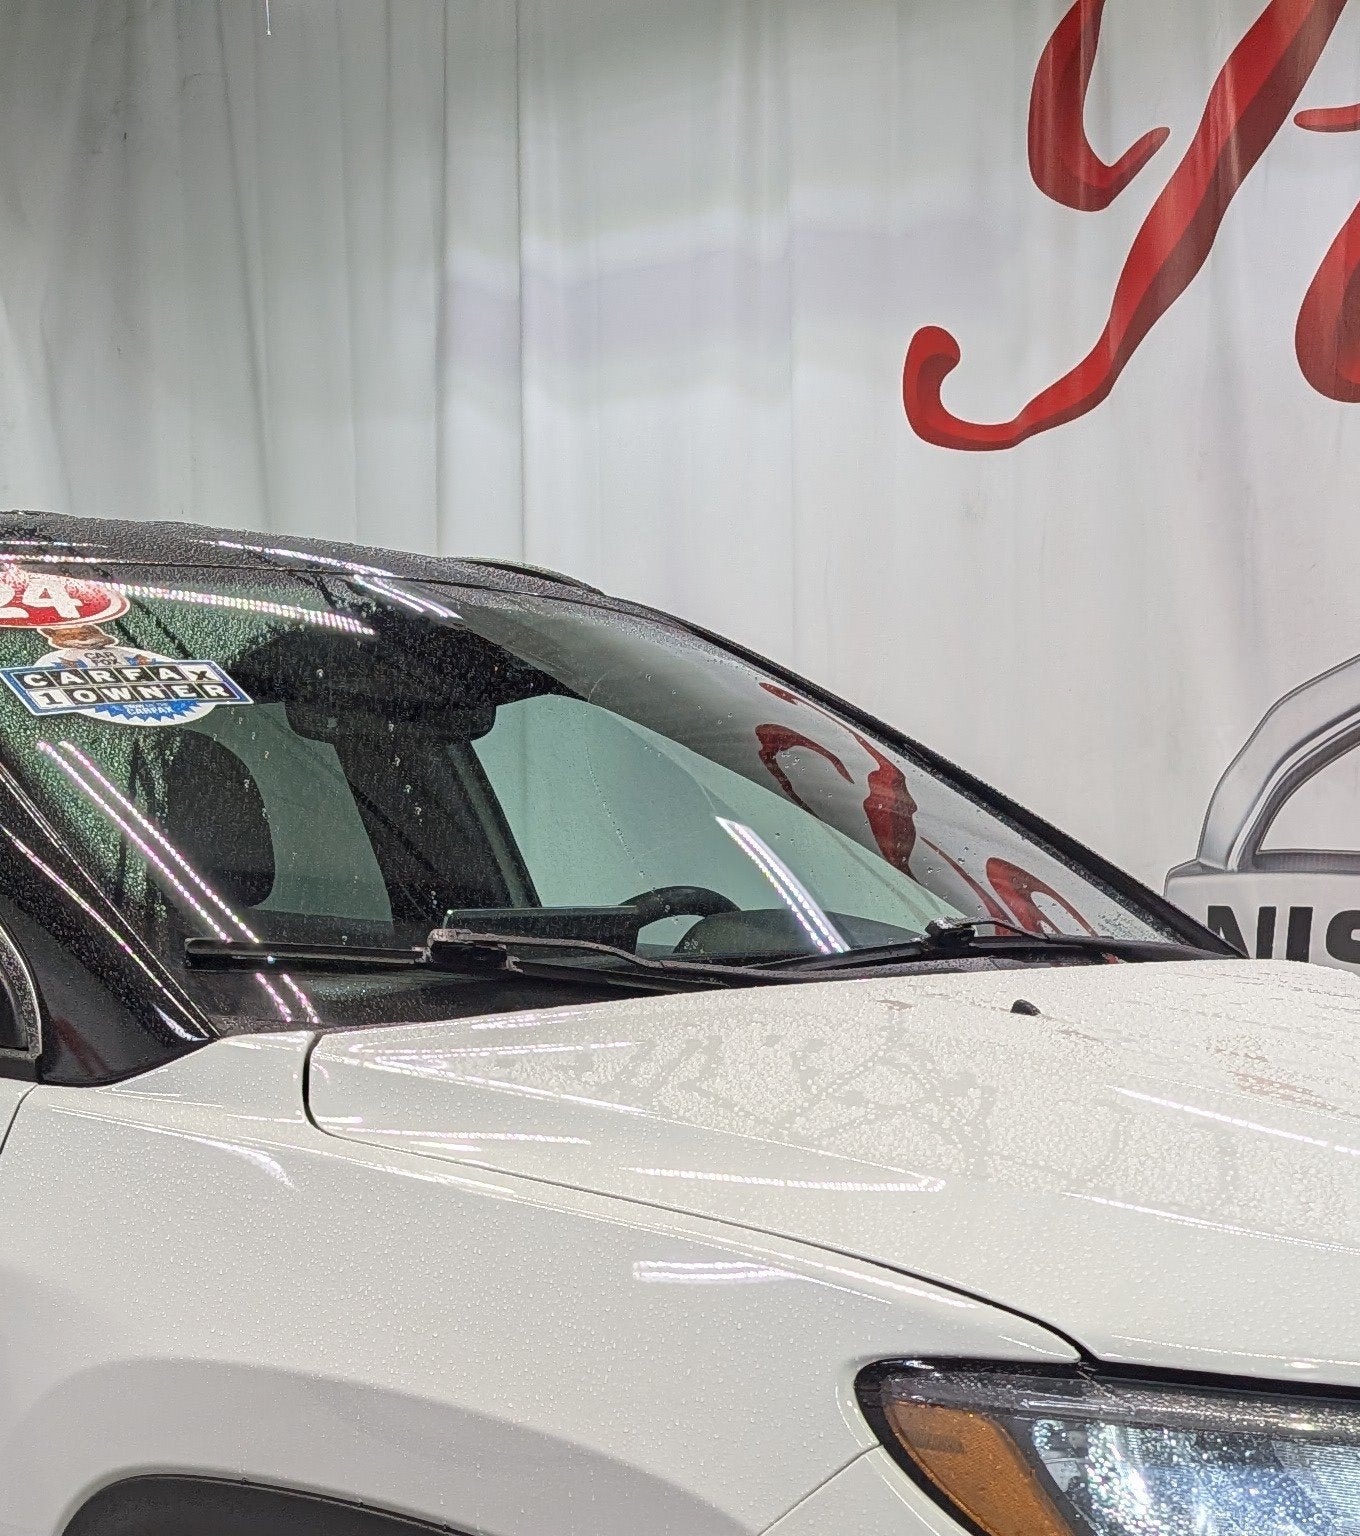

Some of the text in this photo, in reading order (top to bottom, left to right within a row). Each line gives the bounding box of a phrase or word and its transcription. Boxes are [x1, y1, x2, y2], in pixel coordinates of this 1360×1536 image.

[23, 664, 213, 687] CARFAX
[41, 684, 230, 706] 1 OWNER
